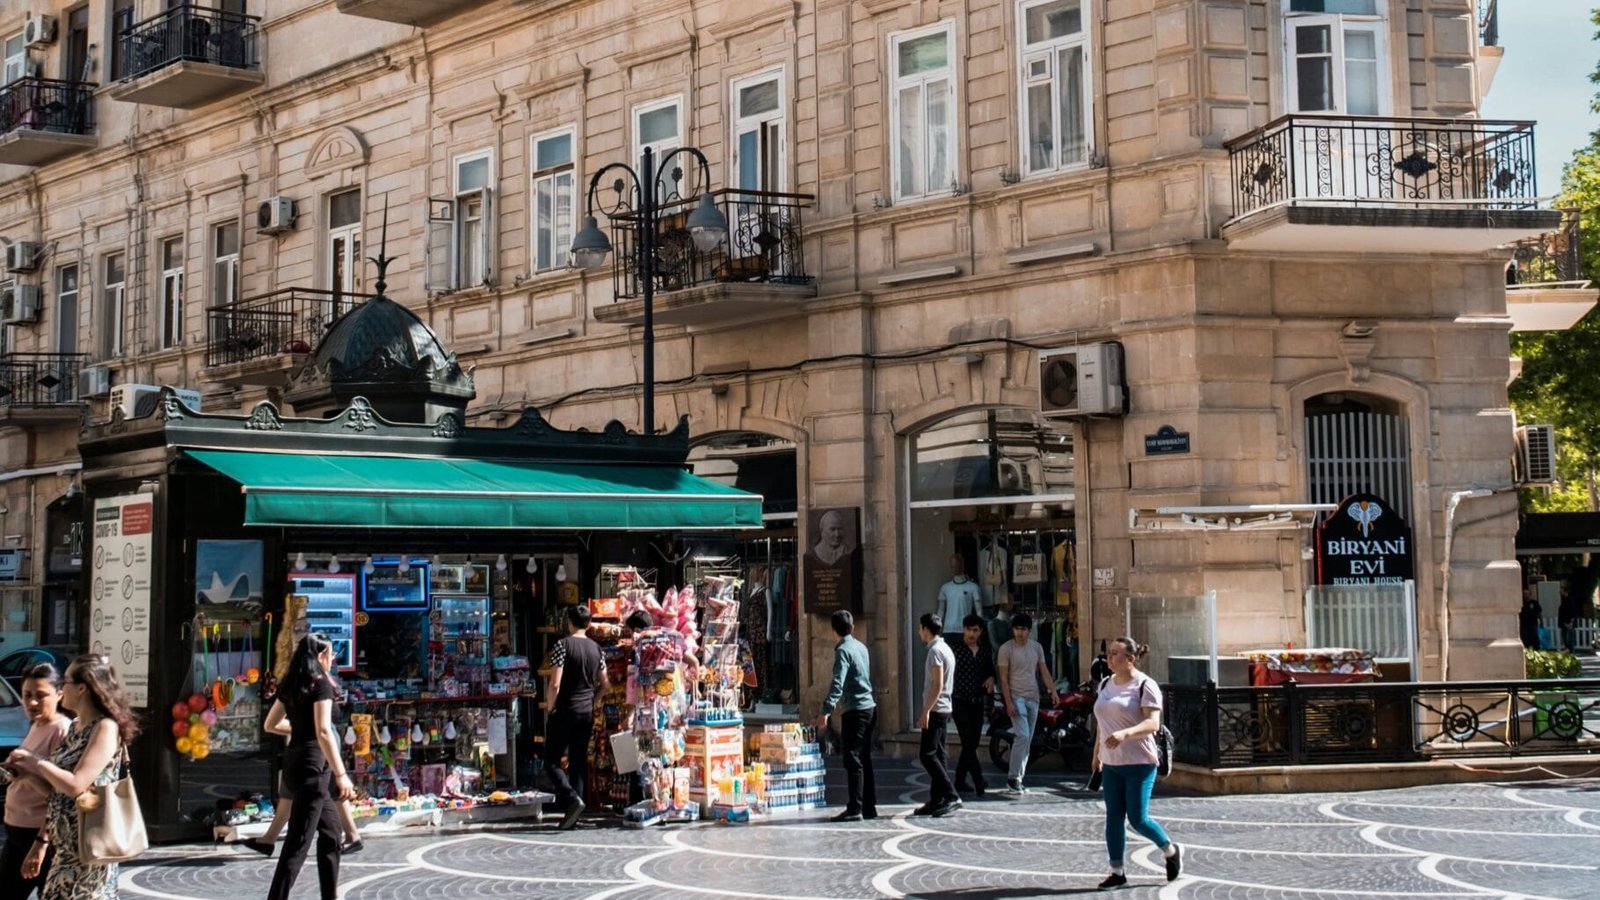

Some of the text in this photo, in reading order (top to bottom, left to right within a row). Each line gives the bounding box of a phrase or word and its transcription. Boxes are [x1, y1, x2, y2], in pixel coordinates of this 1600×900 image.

[1327, 536, 1406, 555] BİRYANİ
[1350, 556, 1385, 574] EVİ
[1333, 577, 1370, 587] BIRYANI
